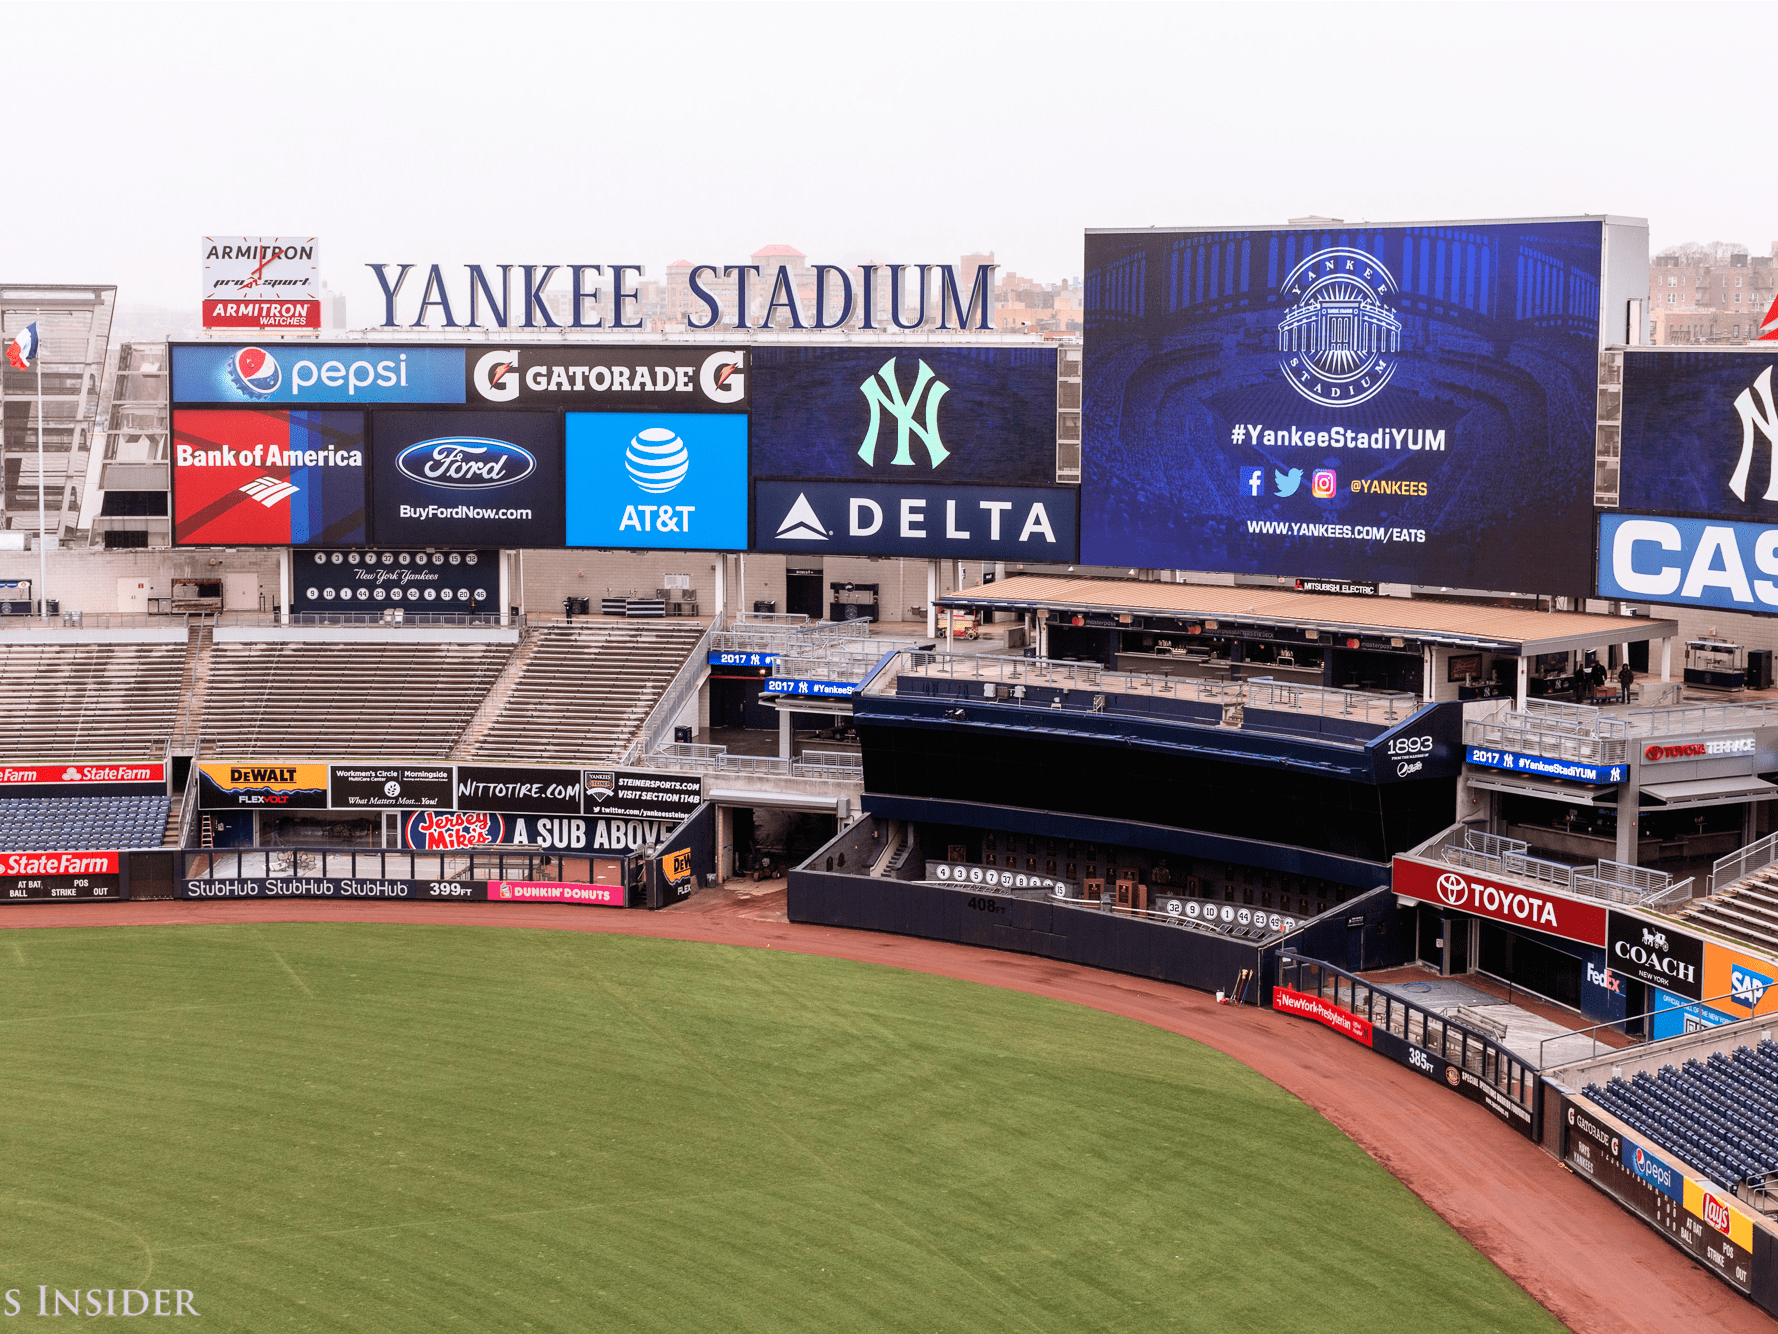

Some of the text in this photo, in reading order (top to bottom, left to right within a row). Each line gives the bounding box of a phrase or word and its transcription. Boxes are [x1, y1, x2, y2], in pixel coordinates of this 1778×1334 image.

[206, 245, 313, 260] ARMITRON
[213, 278, 310, 288] pro sport
[1292, 259, 1388, 296] YANKEE
[364, 263, 1002, 331] YANKEE STADIUM
[212, 303, 308, 317] ARMITRON
[260, 317, 306, 325] WATCHES
[291, 353, 408, 395] pepsi
[526, 364, 694, 392] GATORADE
[1290, 357, 1387, 397] STADIUM
[1231, 424, 1446, 451] #YankeeStadiYUM
[177, 444, 362, 467] Bank of America
[430, 445, 507, 482] Ford
[1351, 479, 1428, 496] @YANKEES
[400, 504, 532, 522] BuyFordNow.com
[619, 504, 696, 533] AT&T
[849, 497, 1057, 543] DELTA
[1247, 521, 1426, 543] WWW.YANKEES.COM/EATS
[318, 554, 323, 562] 4
[335, 554, 340, 562] 3
[451, 555, 459, 563] 15
[468, 555, 476, 563] 32
[353, 569, 439, 585] New York Yankees
[359, 590, 367, 598] 44
[1304, 582, 1375, 594] MITSUBISHI ELECTRIC
[1361, 641, 1393, 650] masterpass
[721, 654, 746, 664] 2017
[769, 681, 794, 691] 2017
[1387, 736, 1433, 755] 1893
[1663, 739, 1756, 758] TOYOTA TERRACE
[1473, 750, 1499, 764] 2017
[1519, 756, 1596, 780] #YankeeStadiYUM
[458, 781, 580, 801] NITTOTIRE.COM
[618, 778, 700, 791] STEINERSPORTS.COM
[239, 795, 288, 804] FLEXVOLT
[369, 797, 396, 805] Matters
[618, 790, 640, 799] VISIT
[641, 791, 680, 802] SECTION
[680, 794, 700, 804] 114B
[419, 811, 489, 834] Jersey
[427, 828, 491, 850] Mike's
[513, 818, 525, 844] A
[537, 818, 586, 849] SUB
[941, 868, 945, 876] 4
[74, 879, 89, 887] POS
[188, 880, 407, 896] StubHub StubHub StubHub
[514, 887, 610, 900] DUNKIN' DONUTS
[1170, 903, 1179, 912] 32
[1190, 906, 1195, 914] 9
[1206, 908, 1214, 916] 10
[1226, 910, 1229, 918] 1
[1240, 912, 1248, 921] 44
[1256, 915, 1264, 923] 23
[1471, 883, 1557, 927] TOYOTA
[1615, 940, 1695, 983] COACH
[1587, 962, 1620, 993] FedEx
[1638, 969, 1669, 986] NEW YORK
[1731, 971, 1764, 1003] SAP
[1577, 1115, 1609, 1146] GATORADE
[1574, 1151, 1594, 1174] YANKEES
[1645, 1160, 1671, 1188] pepsi
[1704, 1194, 1728, 1230] Lay's
[1686, 1217, 1733, 1259] AT BAT POS
[1681, 1227, 1747, 1283] BALL STRIKE OUT
